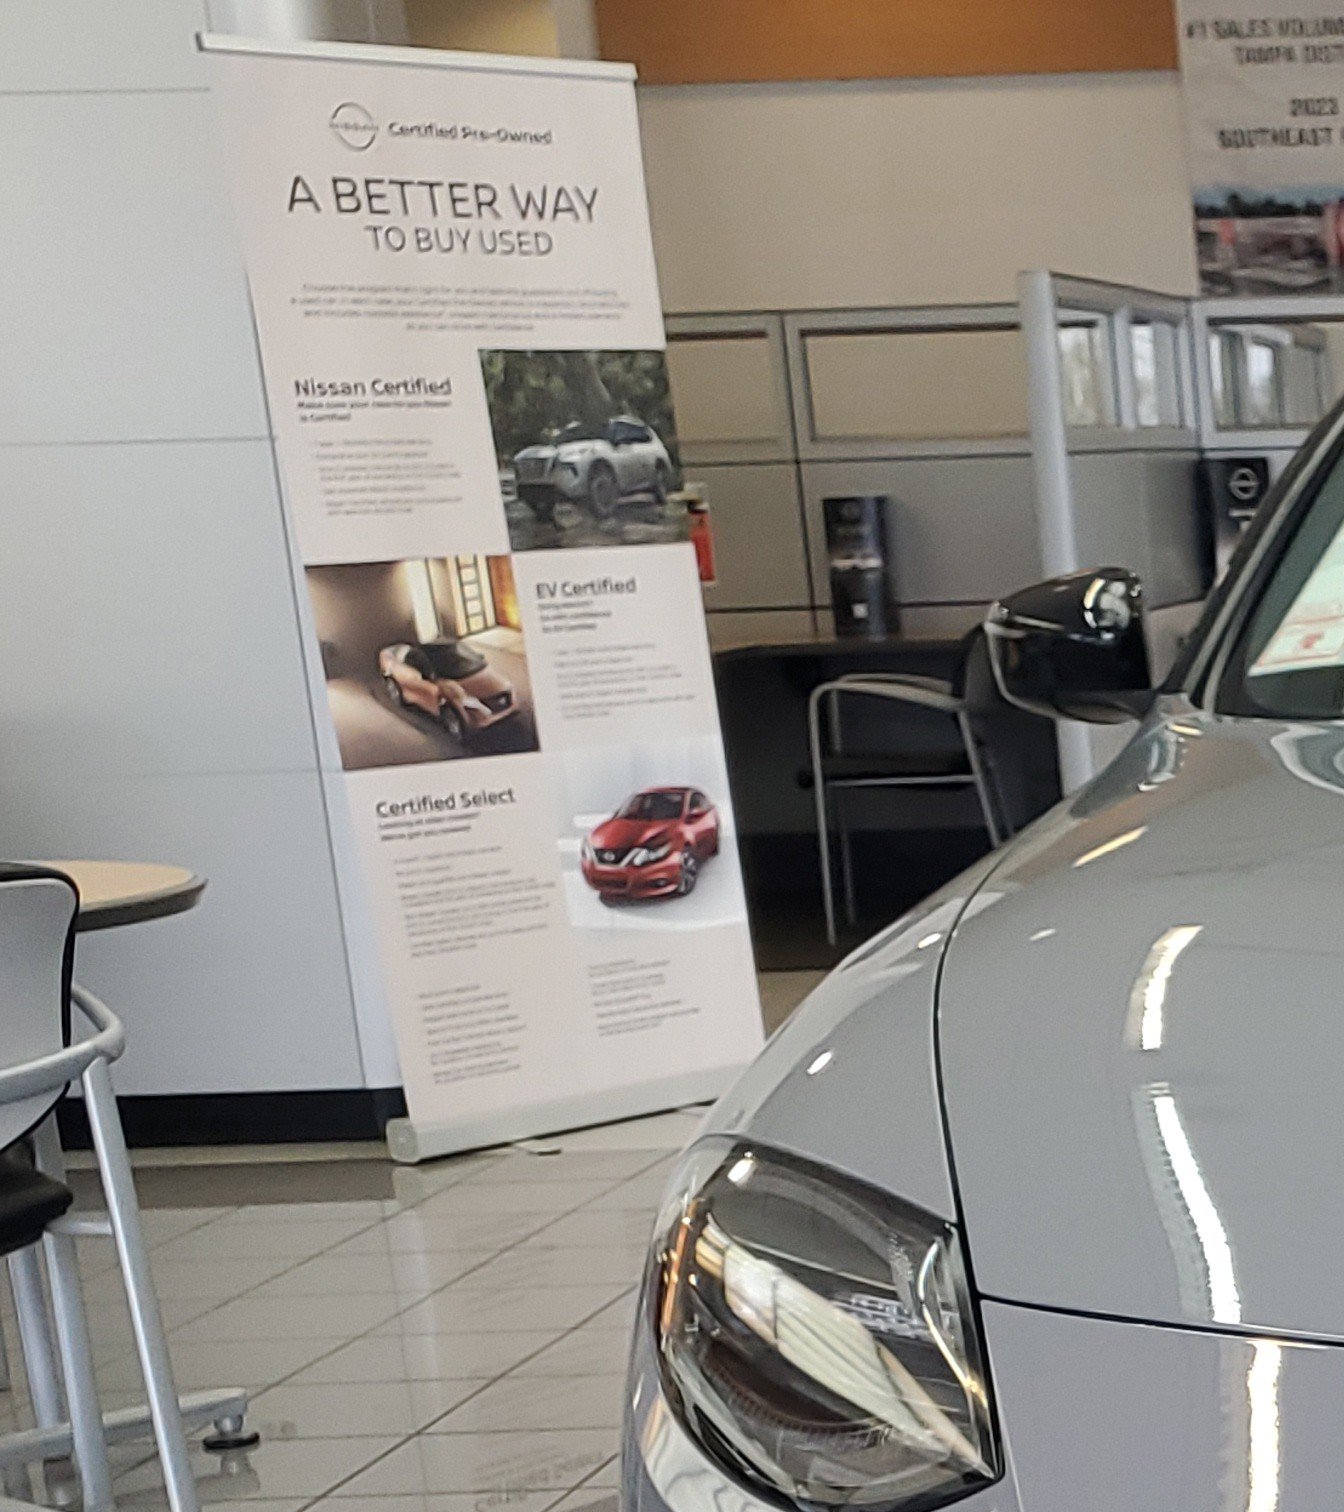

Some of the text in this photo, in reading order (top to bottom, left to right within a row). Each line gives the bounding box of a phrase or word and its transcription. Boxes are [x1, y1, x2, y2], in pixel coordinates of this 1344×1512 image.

[1214, 18, 1271, 38] SALES
[1236, 45, 1296, 64] TAMPA
[389, 121, 553, 144] Certified Pre-Owned
[1218, 127, 1332, 148] SOUTHEAST
[287, 174, 598, 223] A BETTER WAY
[364, 225, 553, 256] TO BUY USED
[294, 376, 453, 397] Nissan Certified
[536, 576, 637, 599] EV Certified
[375, 787, 516, 818] Certified Select
